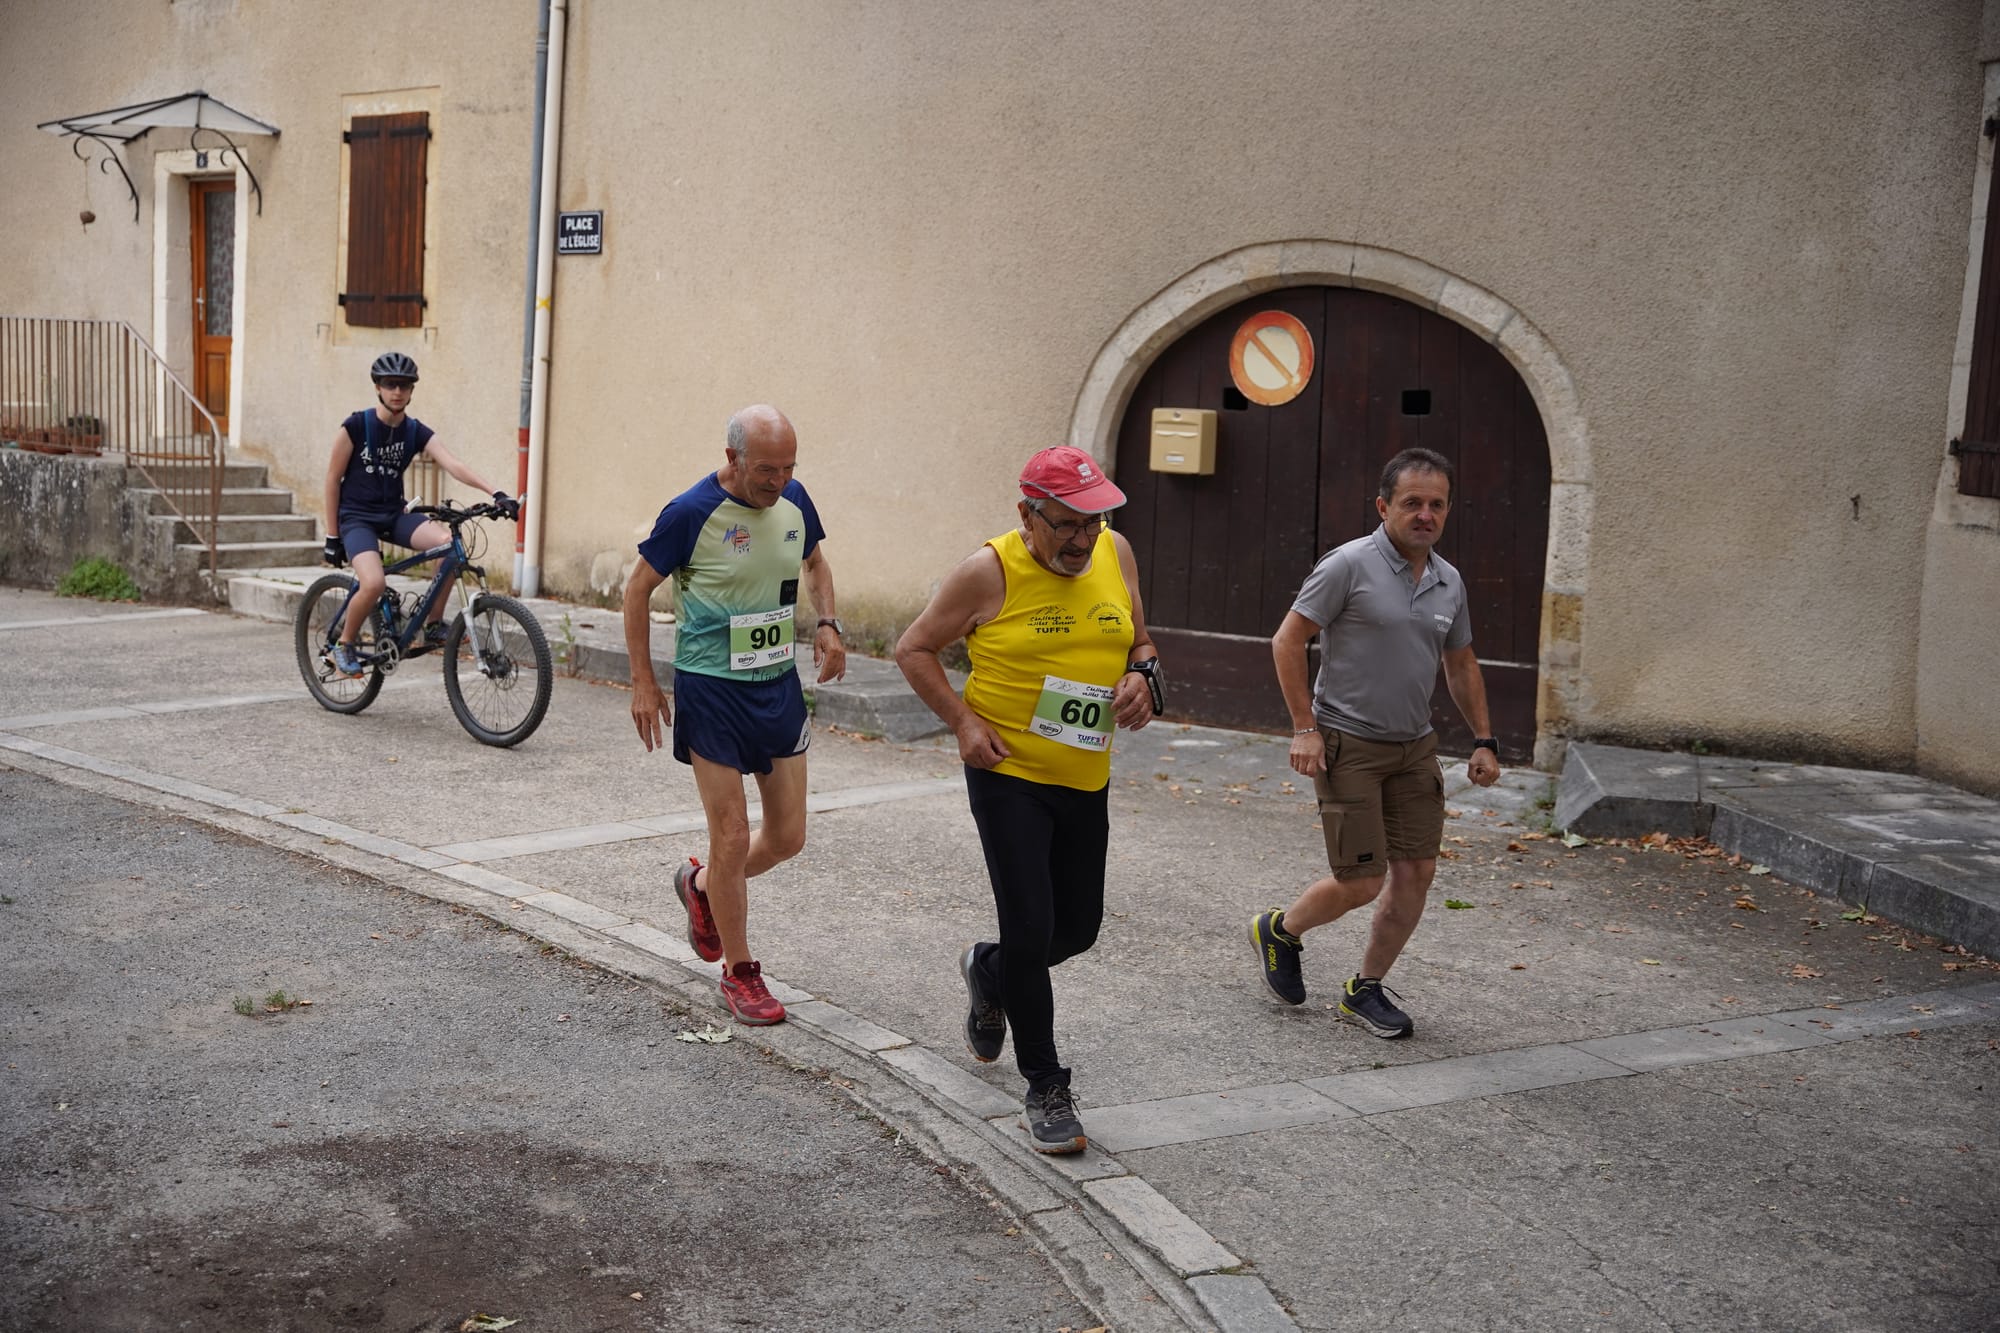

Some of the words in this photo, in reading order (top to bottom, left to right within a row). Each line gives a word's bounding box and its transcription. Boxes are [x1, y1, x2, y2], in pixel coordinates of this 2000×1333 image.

[566, 217, 593, 230] PLACE
[569, 232, 599, 248] L'ÉGLISE
[751, 625, 781, 649] 90
[1061, 699, 1100, 728] 60
[1267, 943, 1278, 972] HOKA
